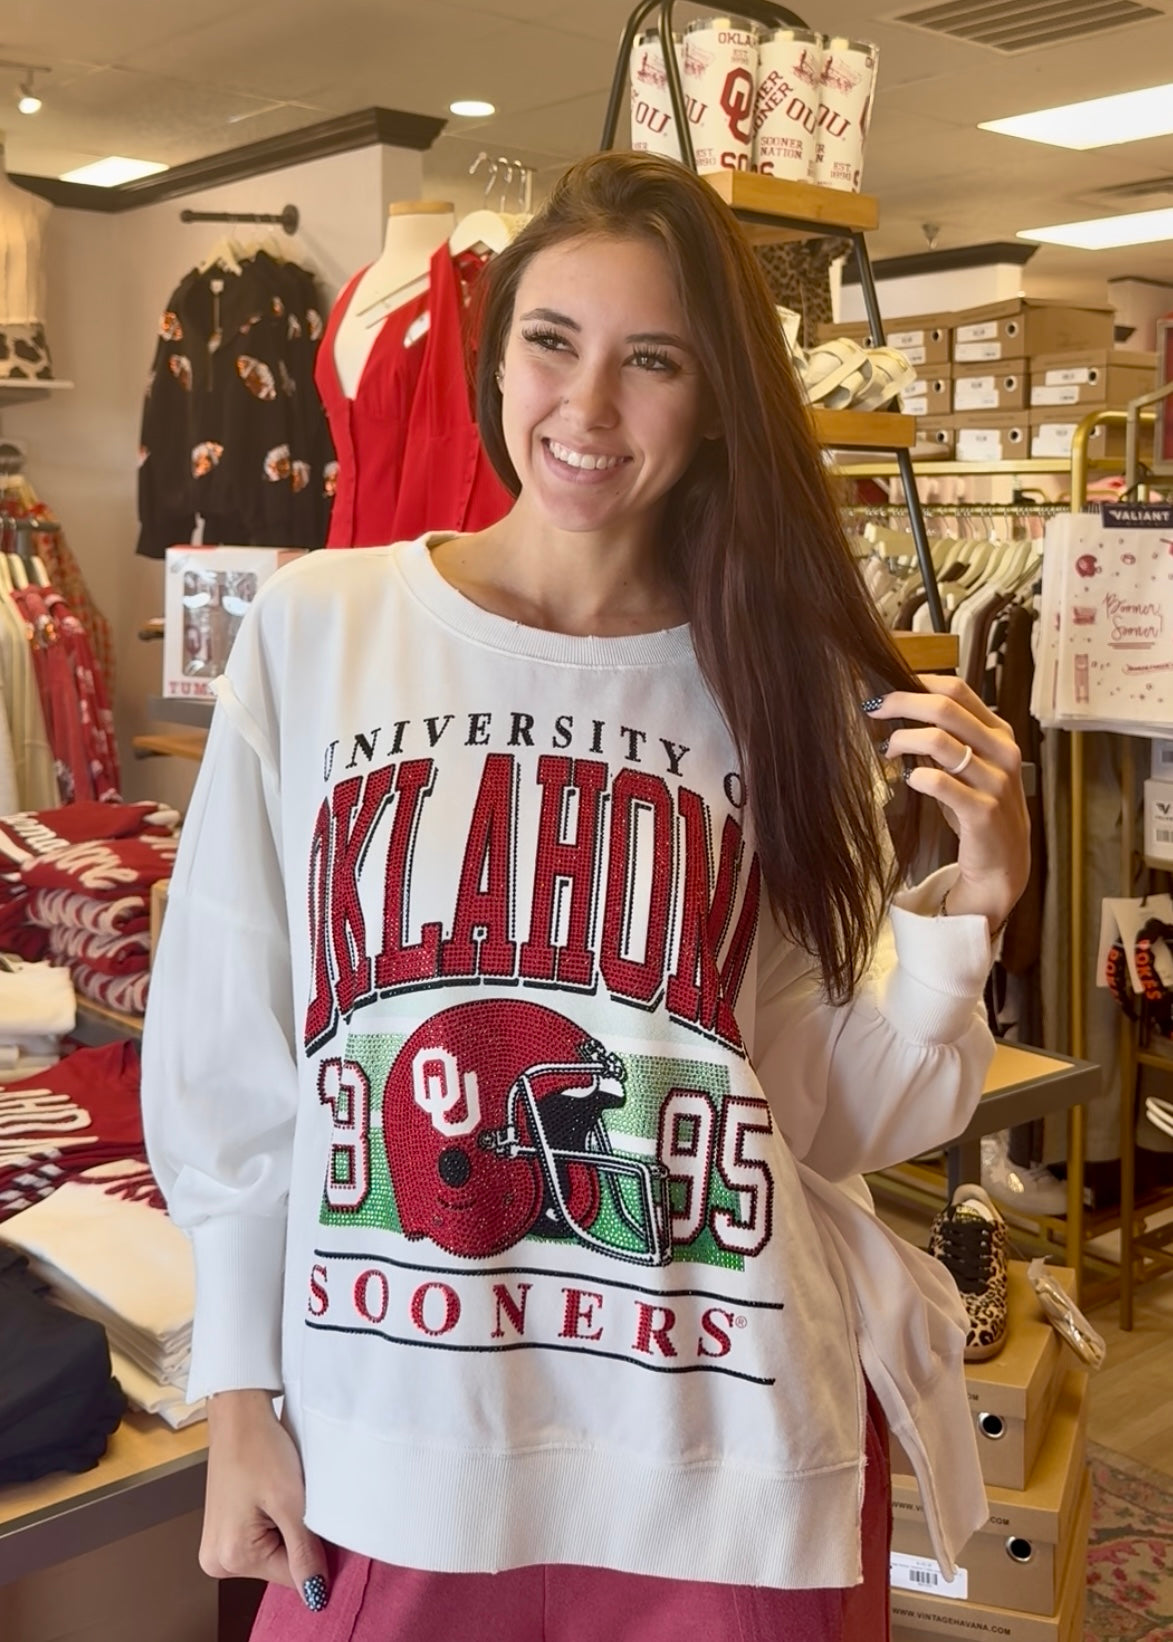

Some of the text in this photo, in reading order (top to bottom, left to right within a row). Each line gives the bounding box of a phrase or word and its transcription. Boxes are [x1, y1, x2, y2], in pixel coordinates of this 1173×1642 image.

[718, 32, 756, 46] OKLA
[635, 101, 671, 133] OU
[685, 94, 708, 124] U
[760, 136, 803, 150] SOONER
[760, 146, 803, 160] NATION
[1108, 510, 1170, 522] VALIANT
[169, 681, 214, 696] TUM
[323, 712, 691, 783] UNIVERSITY
[304, 752, 760, 1060] OKLAHOM
[411, 1046, 482, 1138] OU
[660, 1087, 775, 1258] 95
